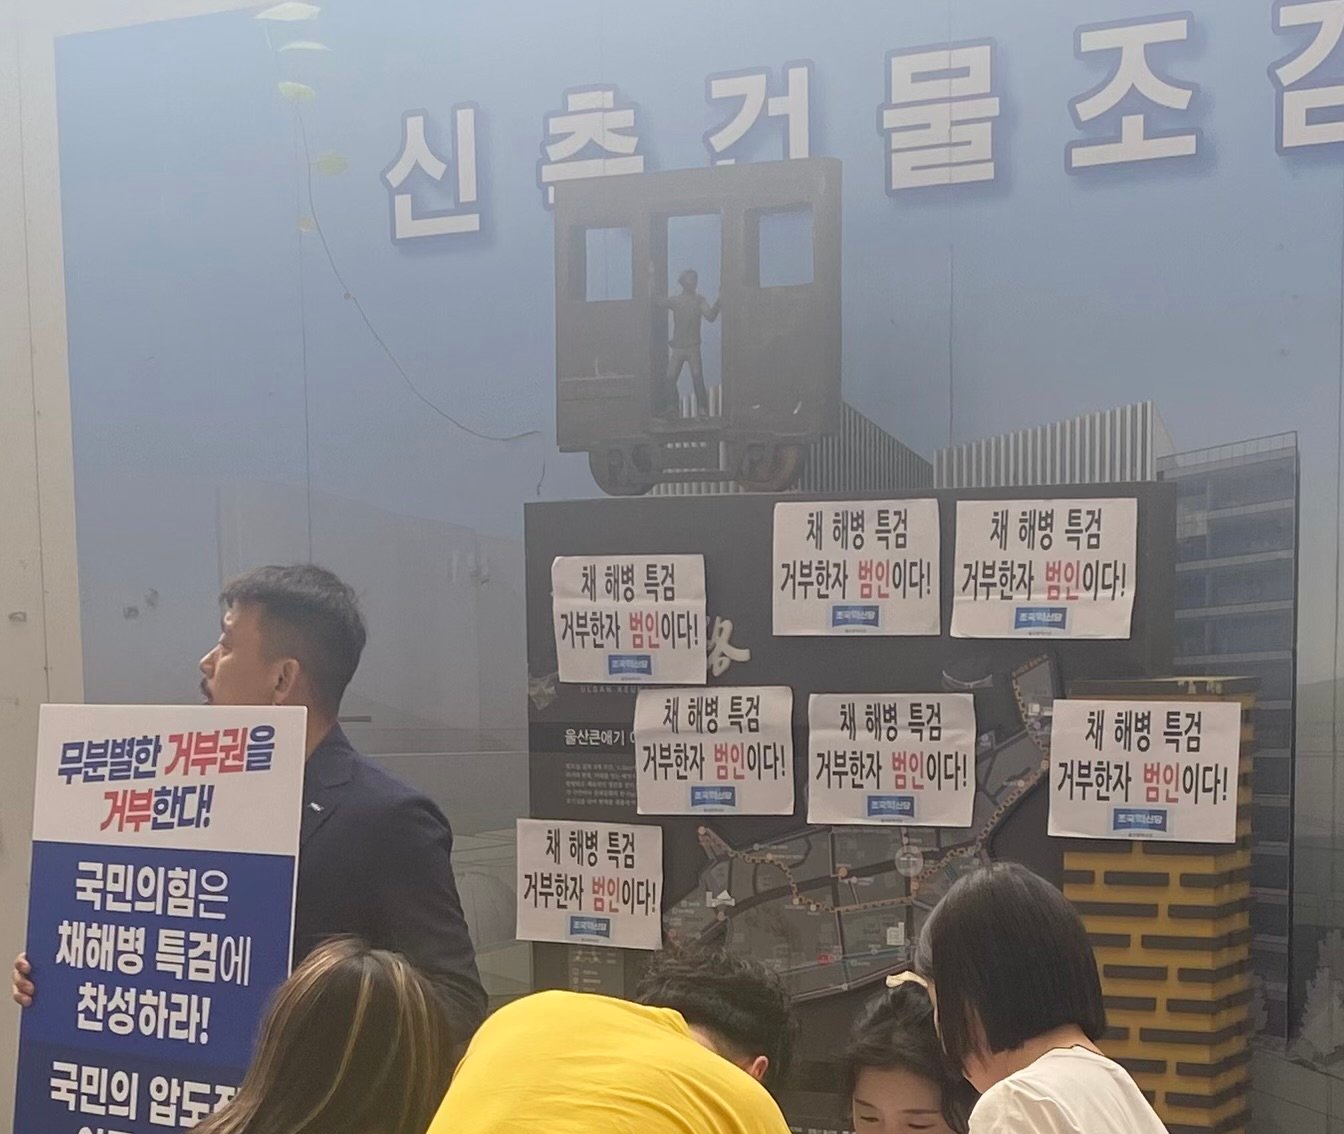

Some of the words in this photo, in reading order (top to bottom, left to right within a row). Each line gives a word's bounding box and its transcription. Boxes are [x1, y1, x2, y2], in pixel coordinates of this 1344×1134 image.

[806, 510, 823, 551] 채
[832, 509, 865, 551] 해병
[875, 508, 908, 551] 특검
[989, 509, 1009, 551] 채
[1018, 508, 1055, 551] 해병
[1064, 508, 1102, 551] 특검
[581, 563, 597, 602] 채
[604, 563, 635, 603] 해병
[643, 562, 675, 603] 특검
[780, 559, 849, 600] 거부한자
[858, 558, 931, 599] 범인이다!
[961, 559, 1035, 602] 거부한자
[1045, 559, 1126, 602] 범인이다!
[559, 611, 621, 650] 거부한자
[629, 610, 699, 650] 범인이다!
[662, 696, 680, 735] 채
[687, 695, 719, 735] 해병
[727, 695, 760, 734] 특검
[839, 702, 857, 742] 채
[864, 702, 898, 742] 해병
[907, 702, 942, 742] 특검
[1085, 709, 1105, 752] 채
[1114, 710, 1151, 753] 해병
[1162, 711, 1202, 753] 특검
[57, 736, 162, 785] 무분별한
[165, 724, 276, 777] 거부권을
[564, 728, 625, 746] 울산큰애기
[642, 742, 705, 781] 거부한자
[714, 741, 786, 781] 범인이다!
[815, 750, 883, 790] 거부한자
[892, 751, 967, 791] 범인이다!
[1057, 759, 1132, 803] 거부한자
[1143, 762, 1228, 805] 범인이다!
[101, 785, 214, 833] 거부한다!
[545, 828, 561, 865] 채
[568, 829, 598, 867] 해병
[606, 831, 635, 869] 특검
[75, 862, 229, 920] 국민의힘은
[523, 871, 584, 911] 거부한자
[592, 876, 656, 916] 범인이다!
[57, 920, 146, 976] 채해병
[155, 930, 250, 987] 특검에
[78, 982, 211, 1045] 찬성하라!
[50, 1061, 137, 1119] 국민의
